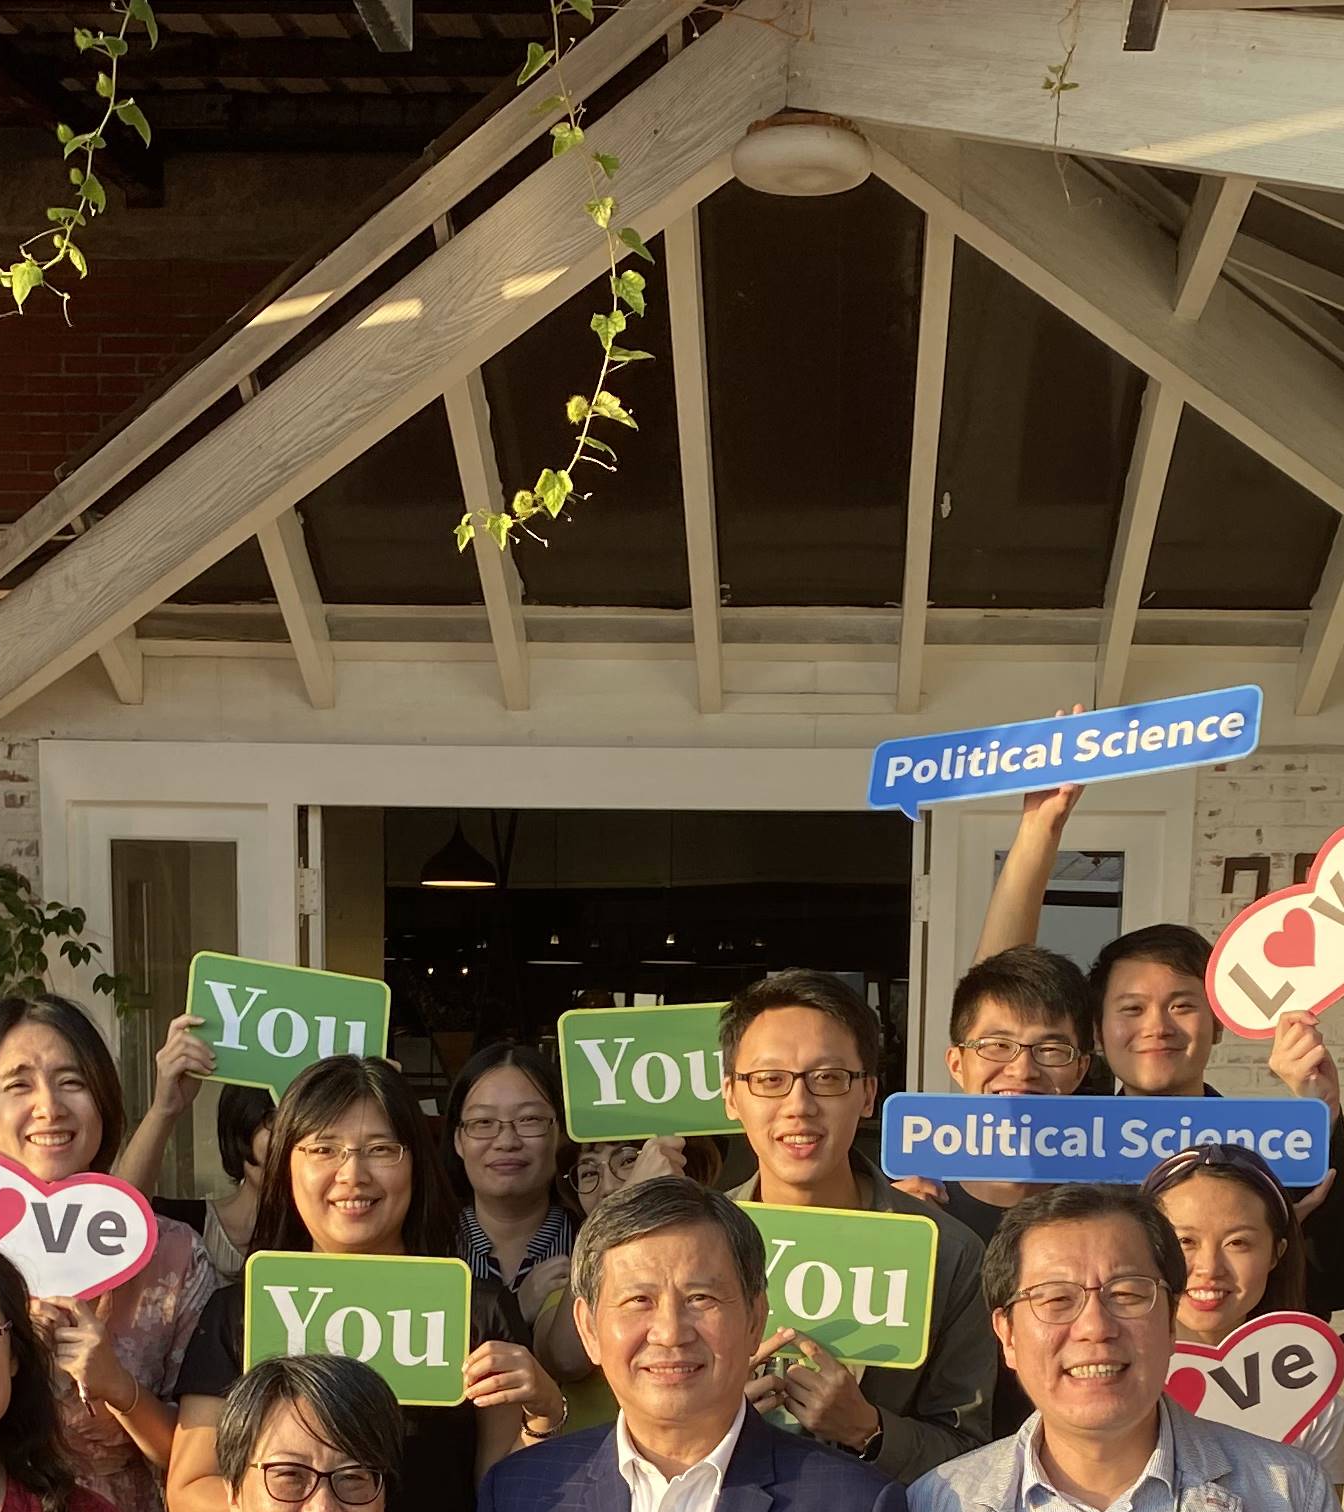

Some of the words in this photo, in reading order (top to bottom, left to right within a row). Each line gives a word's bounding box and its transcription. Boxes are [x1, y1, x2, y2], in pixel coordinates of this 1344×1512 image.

[884, 733, 1063, 788] Political
[1072, 708, 1246, 763] Science
[204, 979, 367, 1060] You
[901, 1113, 1106, 1158] Political
[766, 1239, 910, 1327] ou
[263, 1285, 450, 1367] You
